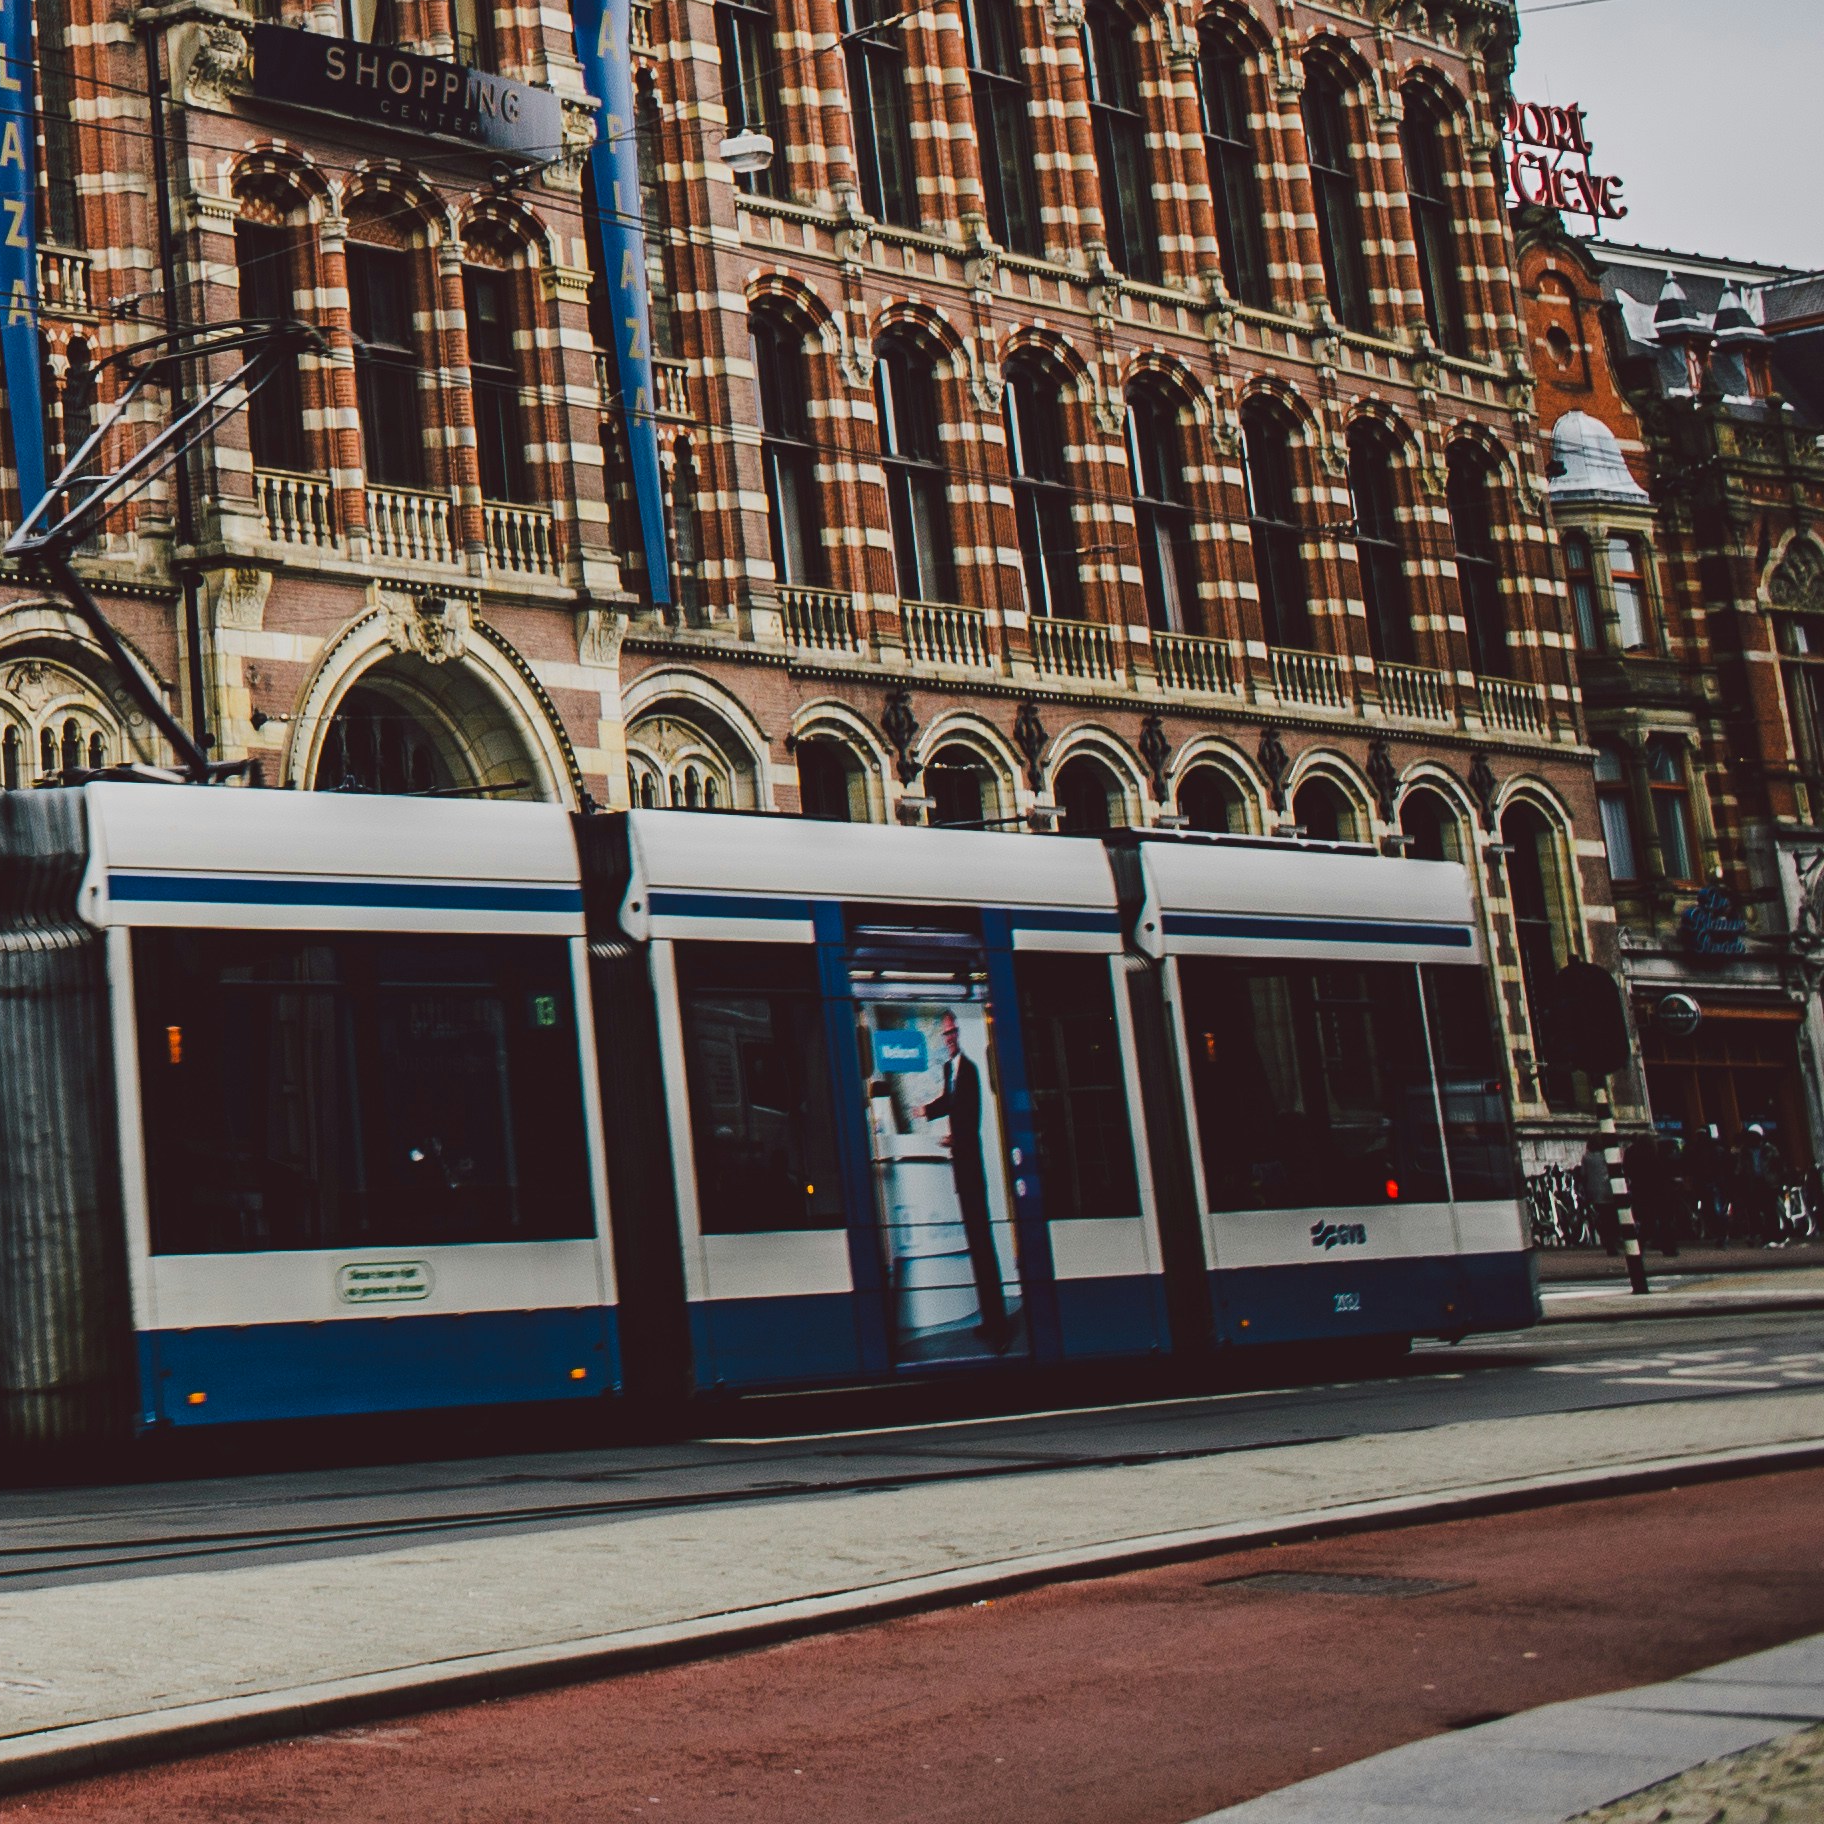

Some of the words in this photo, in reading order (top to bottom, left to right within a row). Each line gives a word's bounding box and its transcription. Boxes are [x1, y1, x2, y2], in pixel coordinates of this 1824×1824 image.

[325, 46, 521, 125] SHOPPING
[380, 100, 478, 134] CENTER
[607, 113, 649, 427] PLAZA
